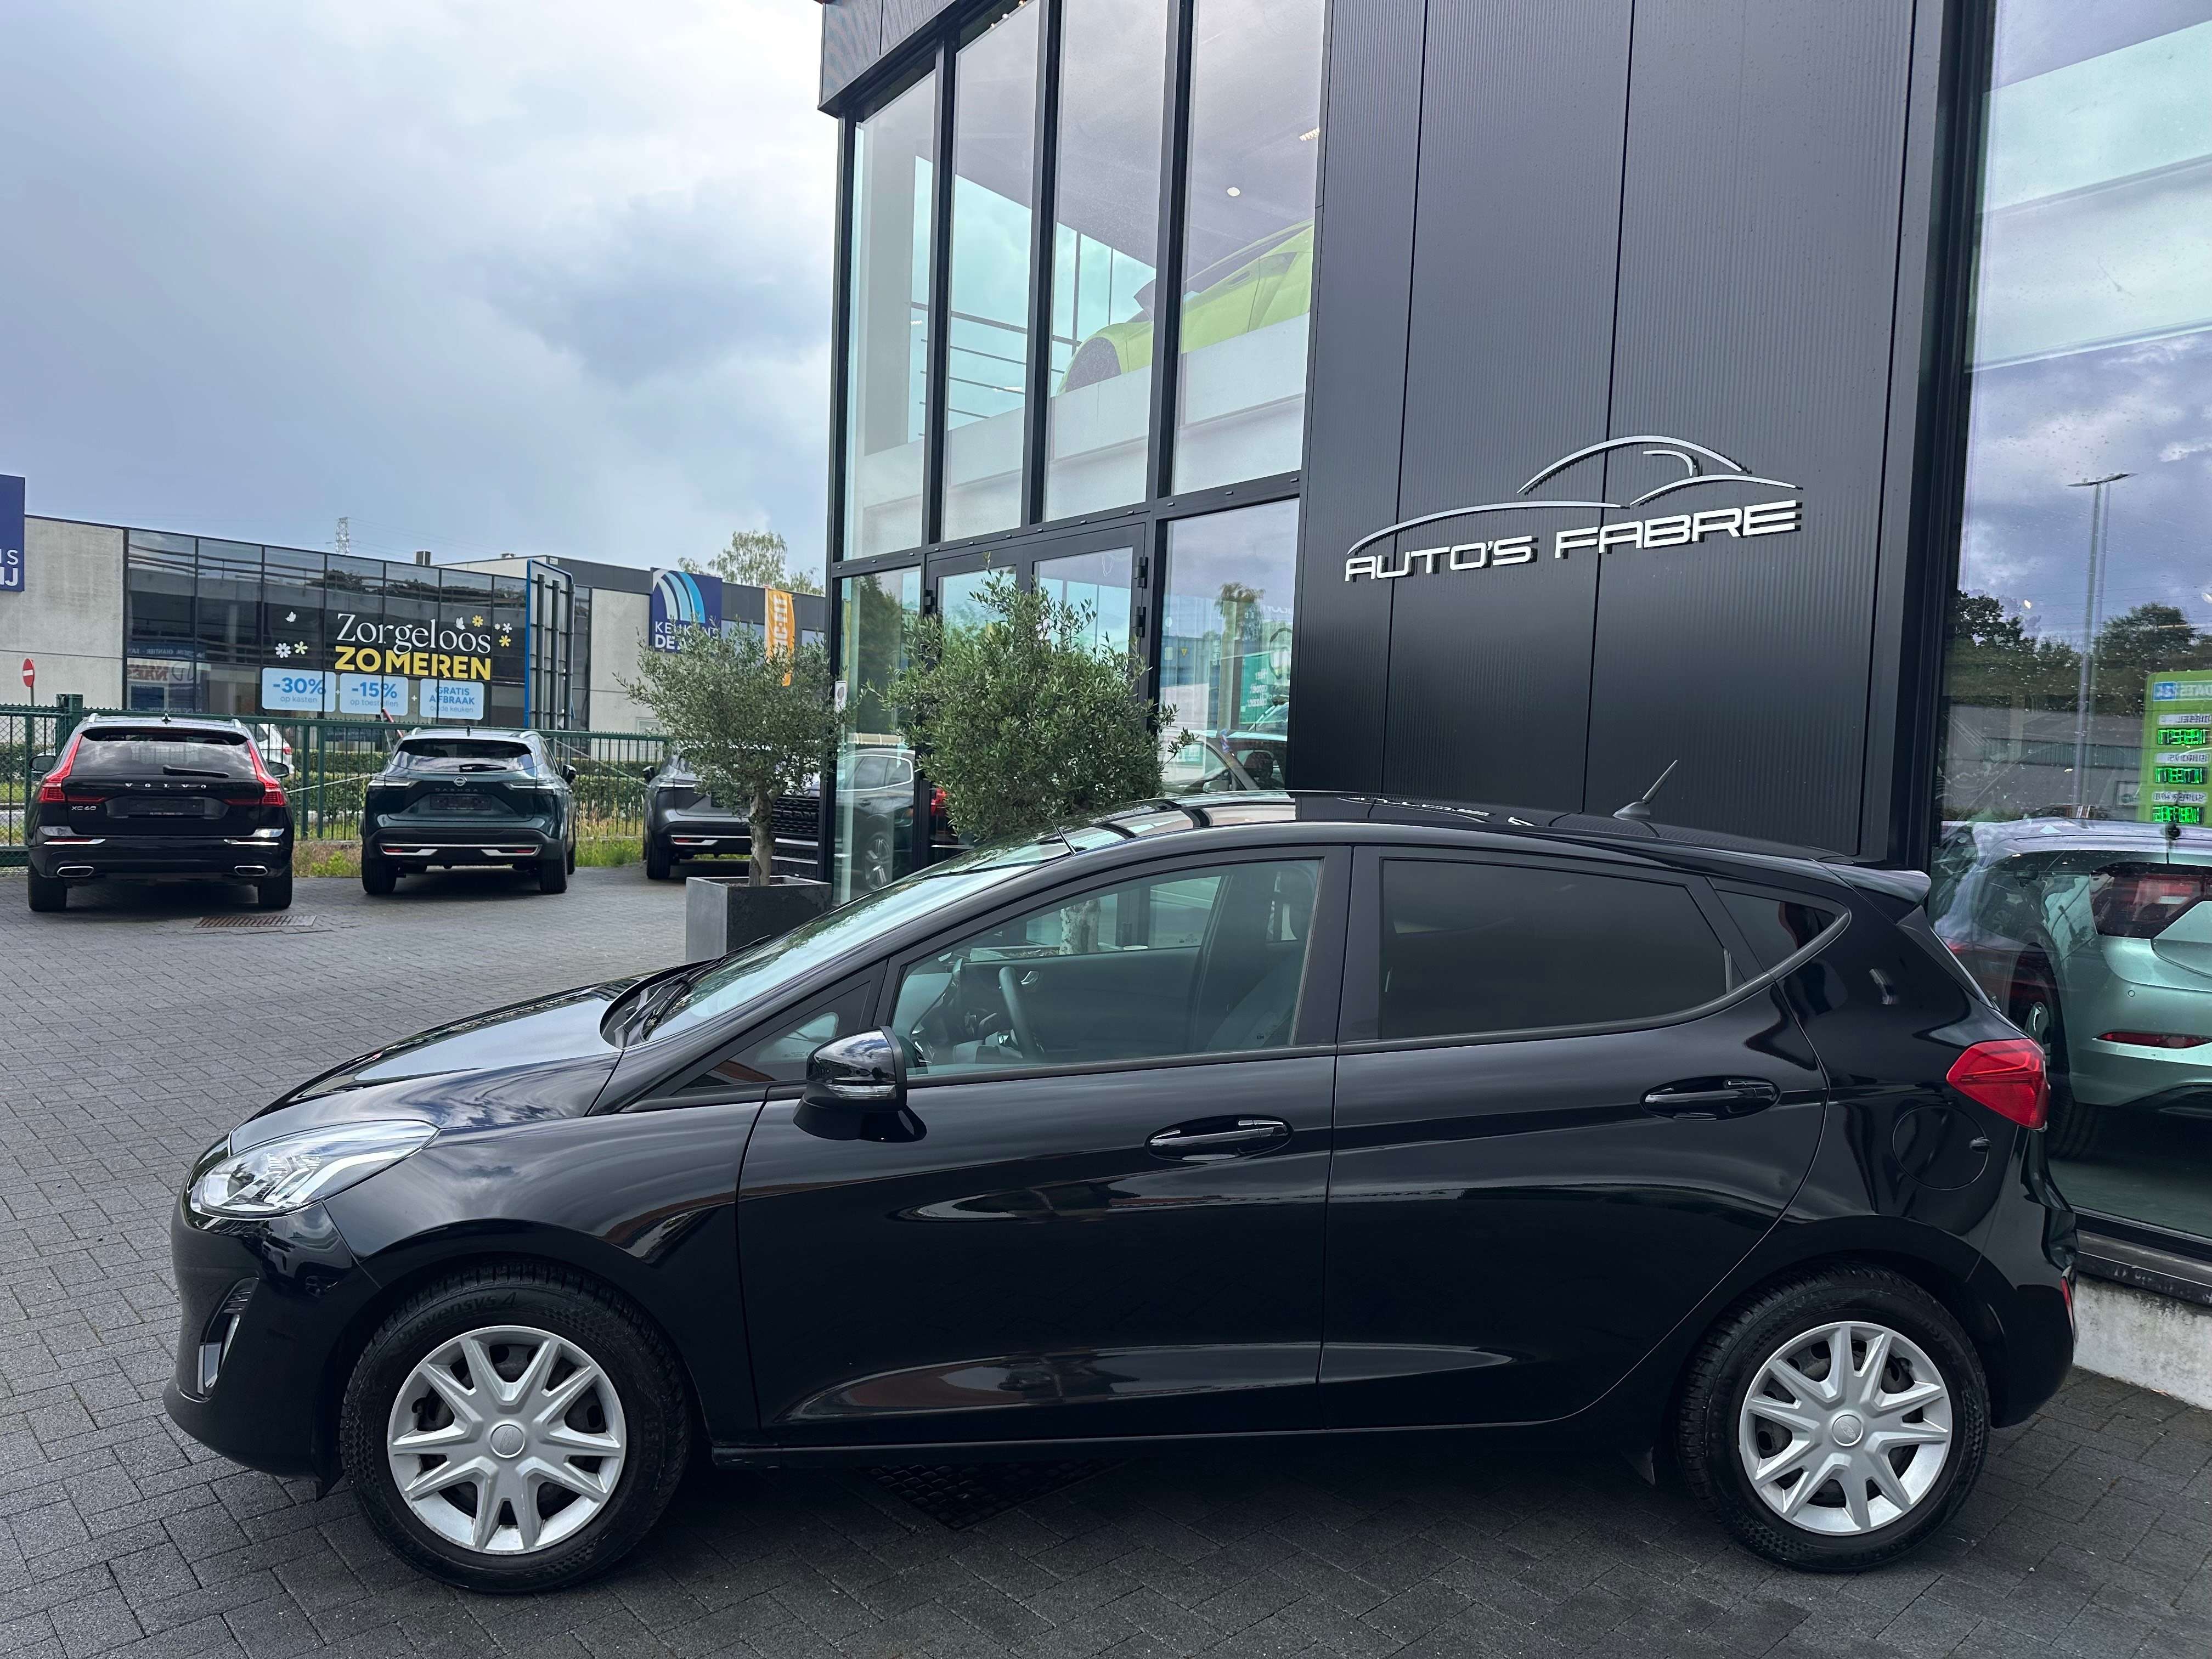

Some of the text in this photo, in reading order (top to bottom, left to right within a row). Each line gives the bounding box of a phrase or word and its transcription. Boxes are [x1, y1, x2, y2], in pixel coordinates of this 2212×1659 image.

[1345, 500, 1797, 582] AUTO'S FABRE
[0, 549, 18, 566] S
[337, 613, 491, 654] Zorgeloos
[655, 621, 719, 639] KEUKNS
[335, 645, 491, 680] ZOMEREN
[273, 677, 326, 695] -30%
[352, 681, 397, 698] -15%
[435, 687, 470, 696] GRATIS
